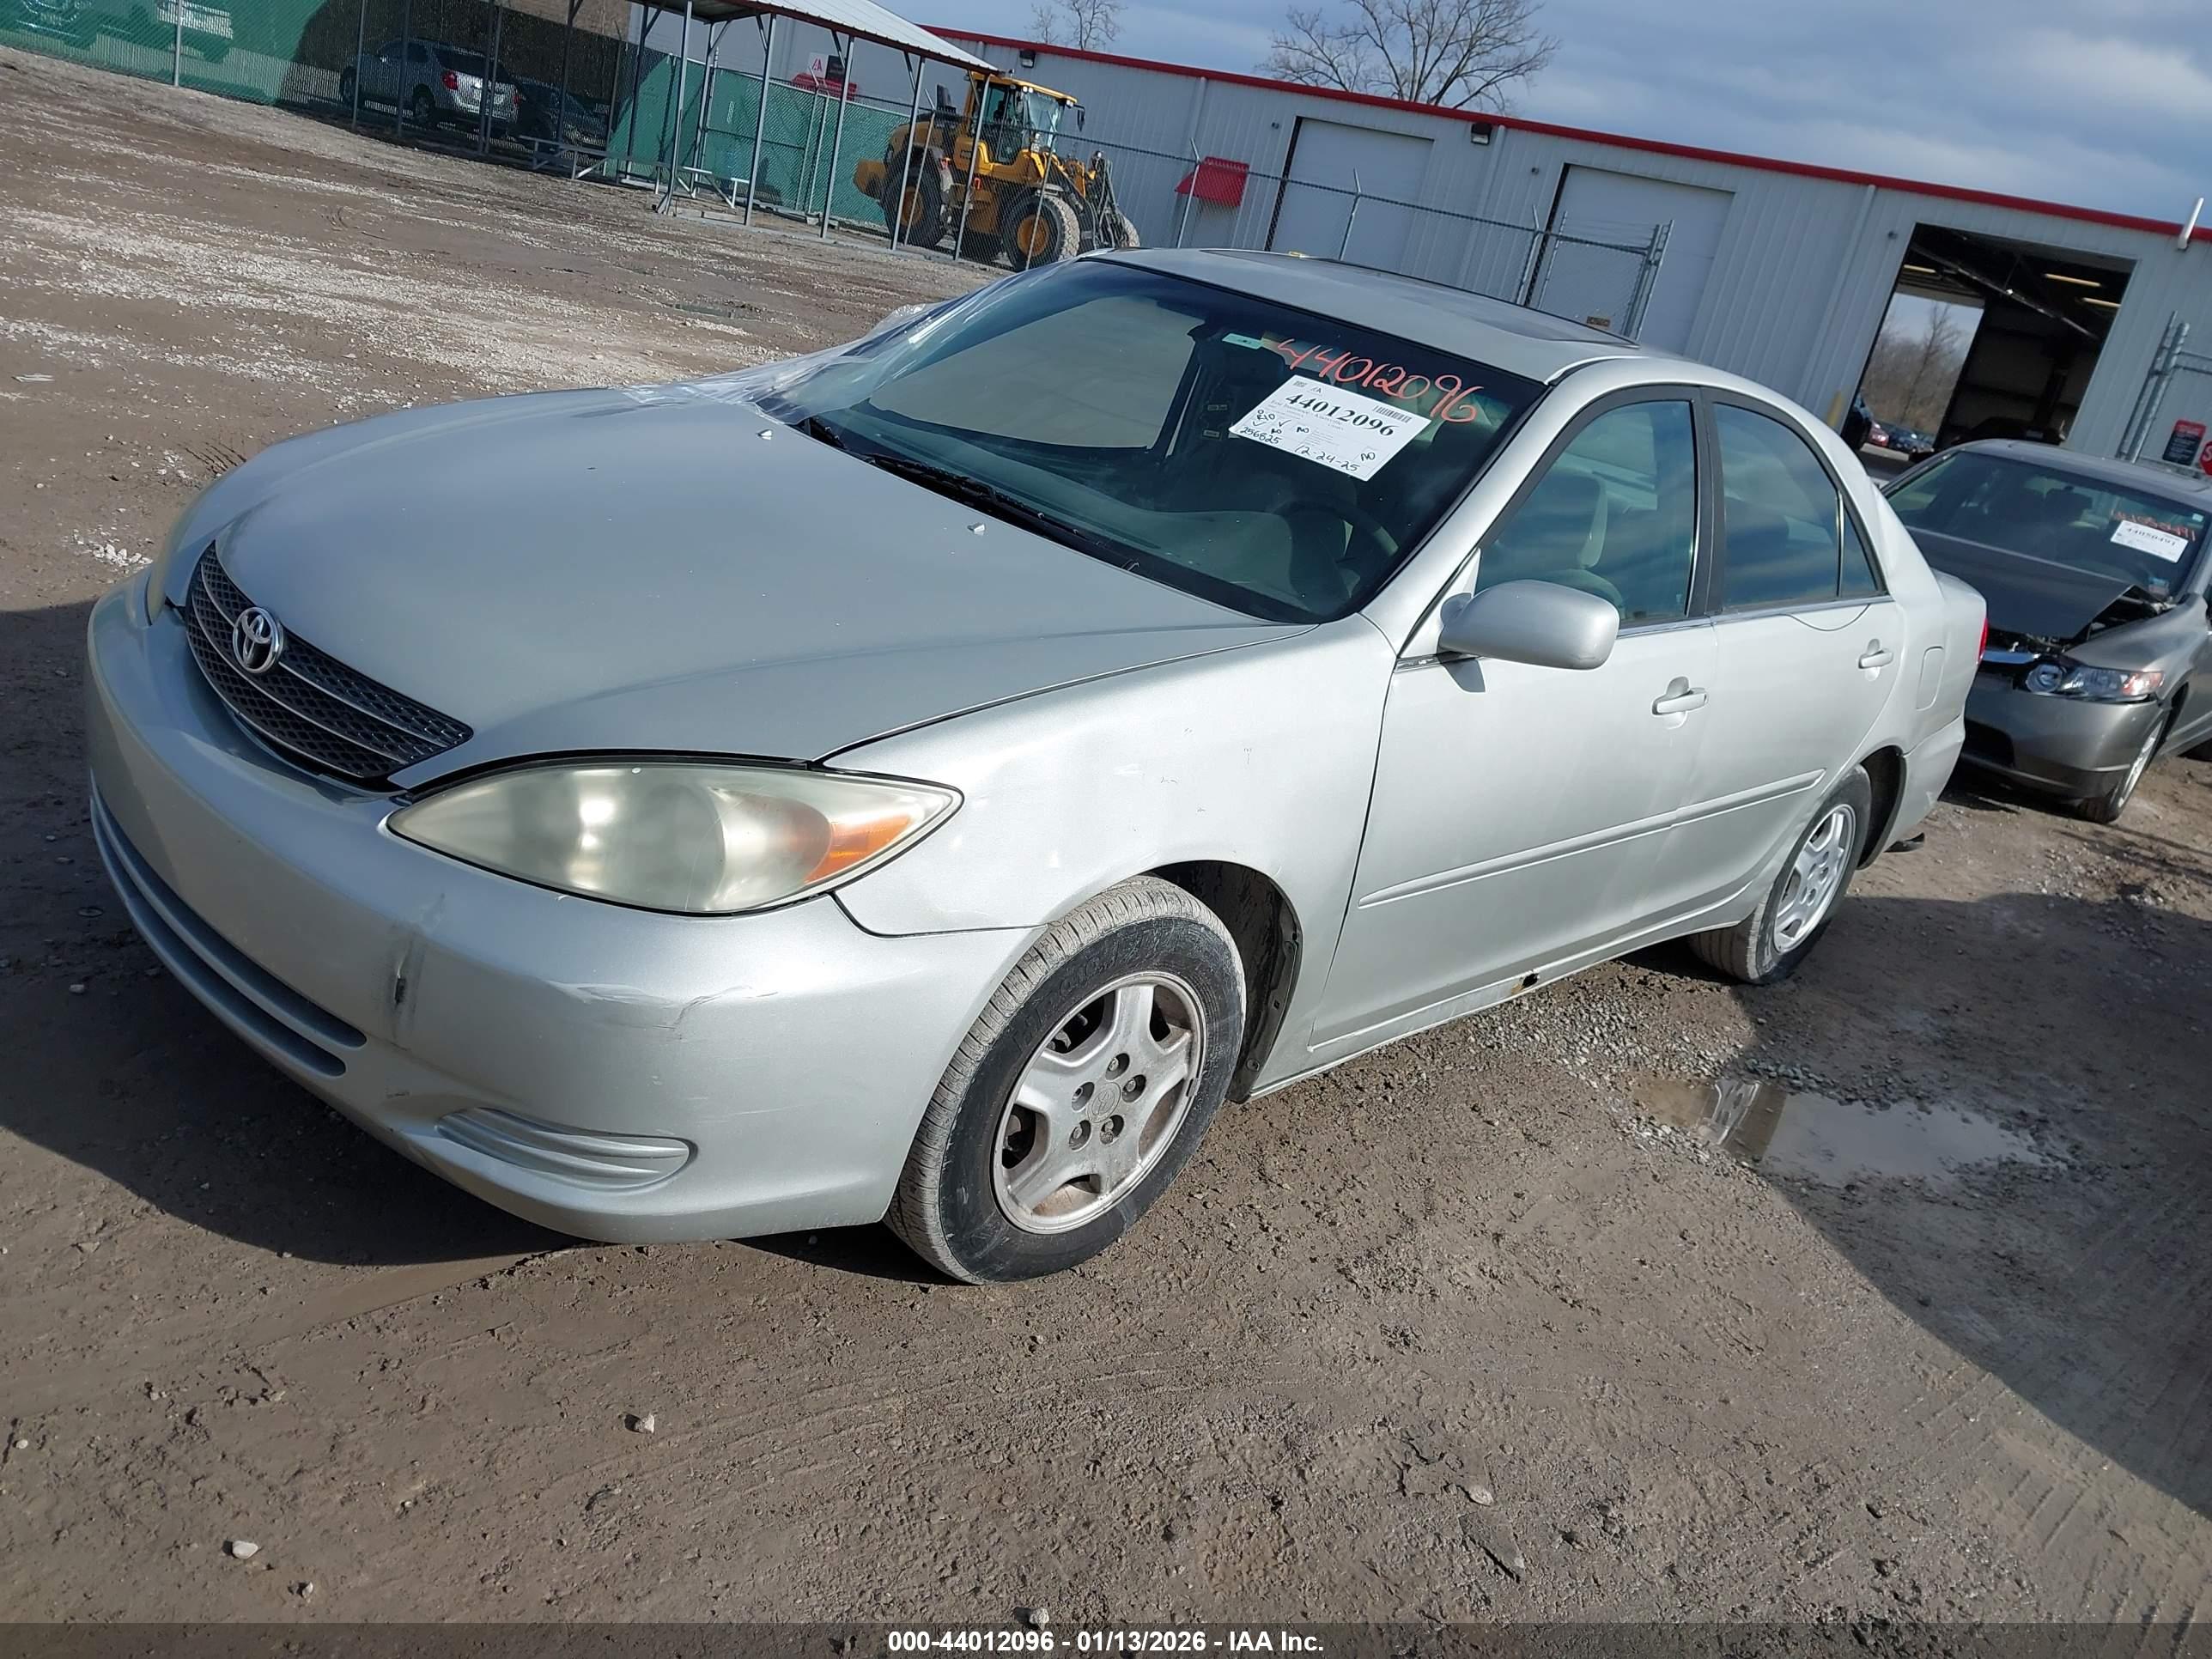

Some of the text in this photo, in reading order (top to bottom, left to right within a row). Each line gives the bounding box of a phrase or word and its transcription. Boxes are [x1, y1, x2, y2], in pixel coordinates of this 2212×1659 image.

[1277, 337, 1485, 422] 44012096
[1240, 426, 1282, 444] 256825
[1285, 393, 1401, 437] 44012096
